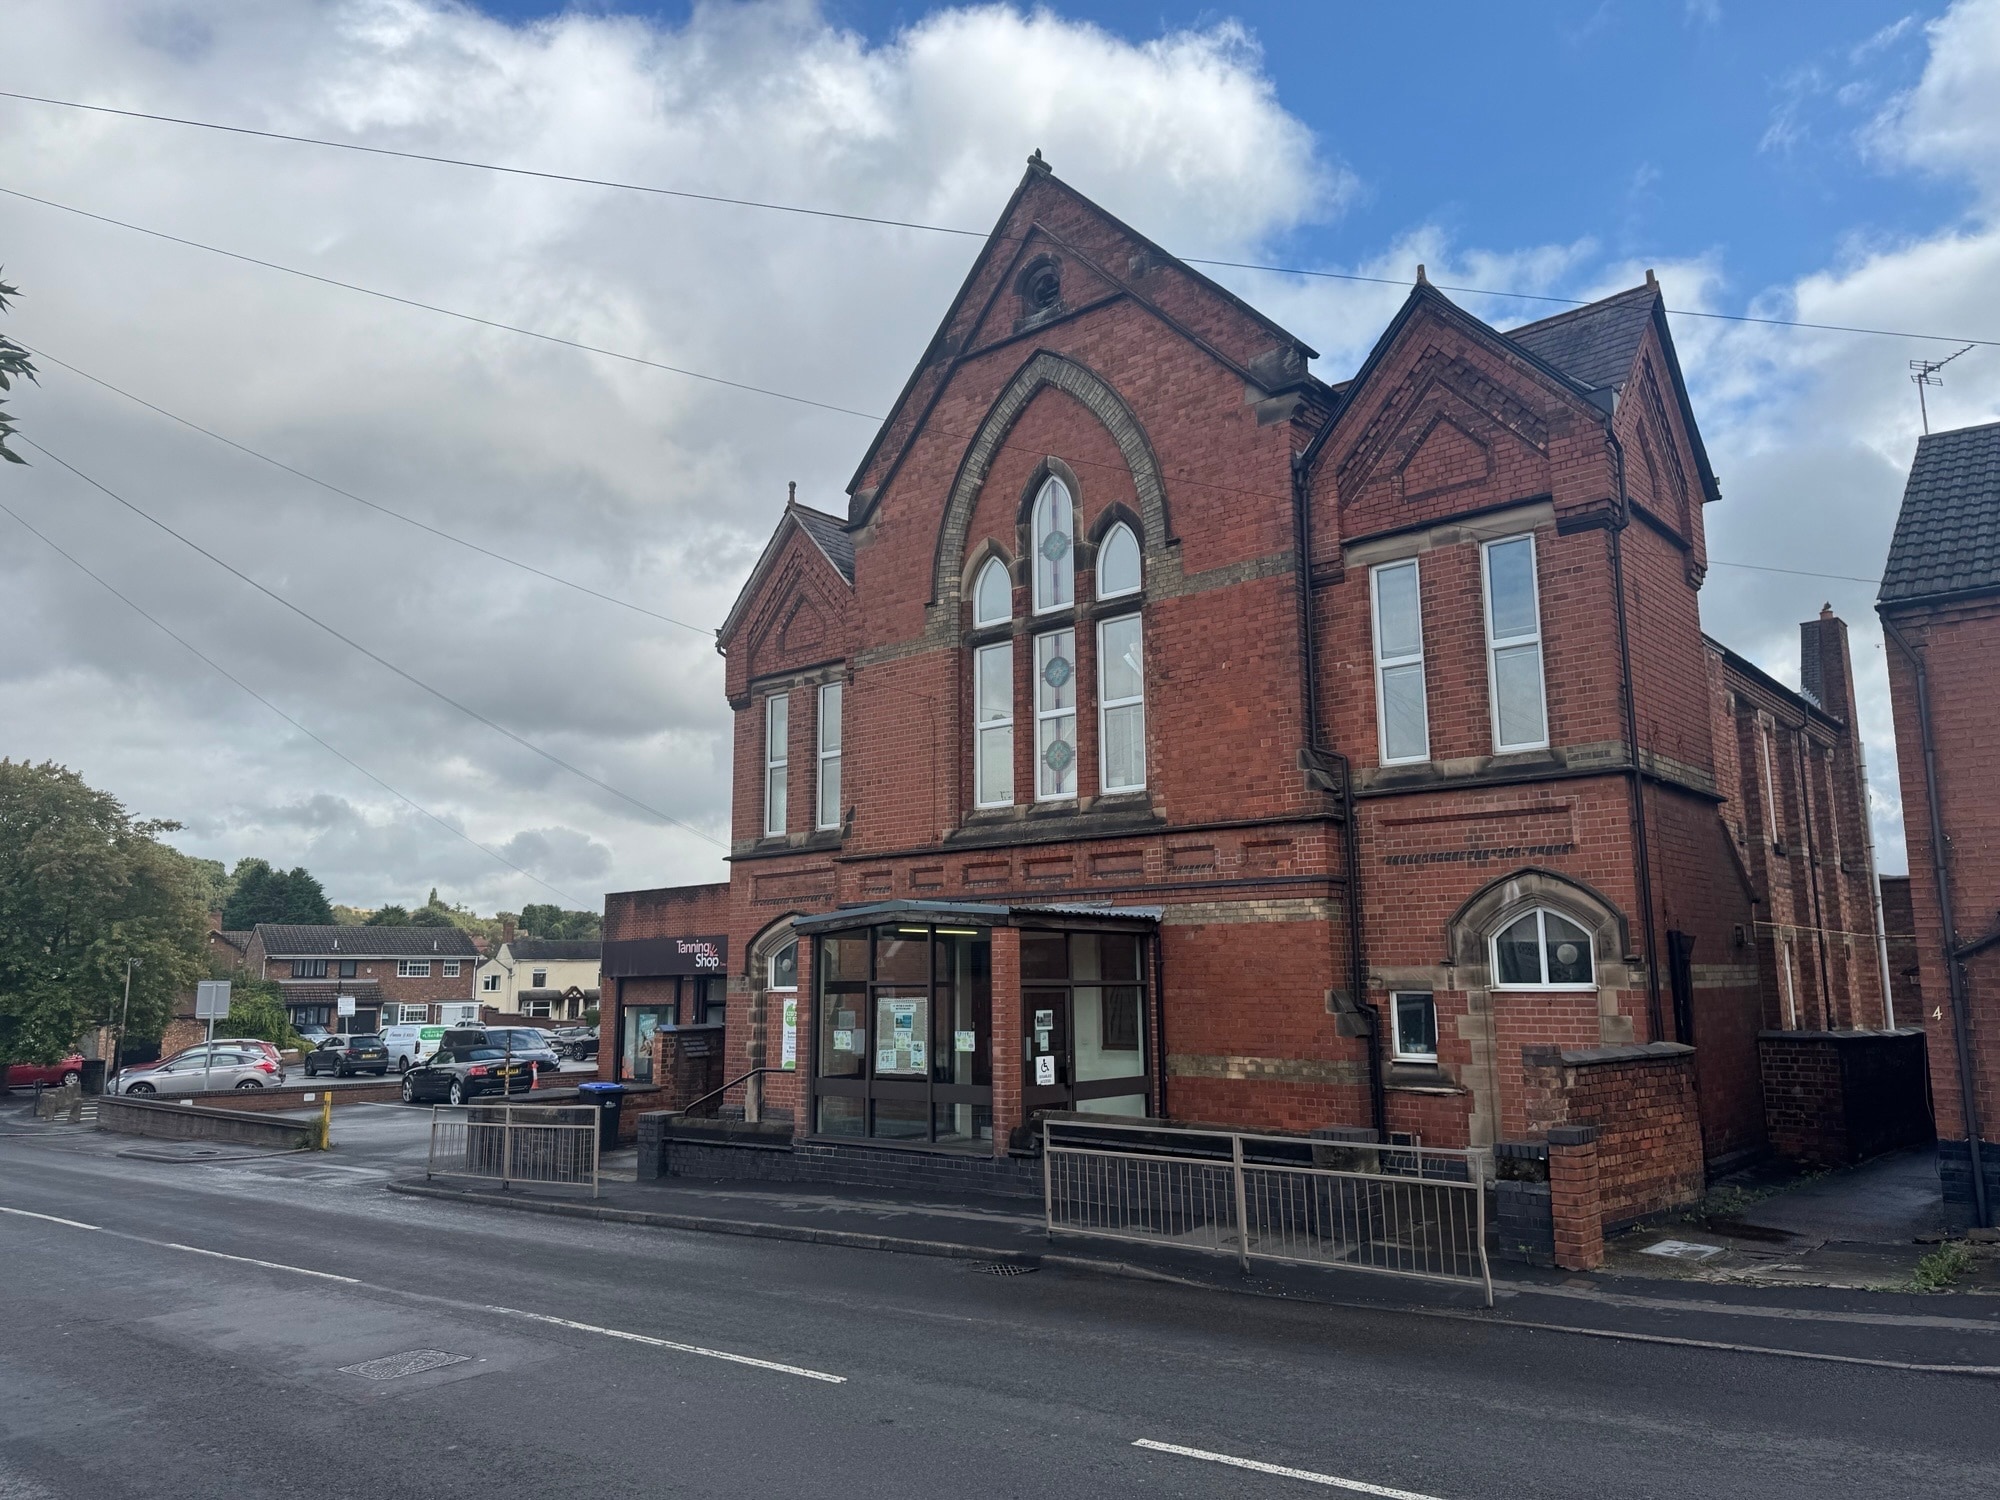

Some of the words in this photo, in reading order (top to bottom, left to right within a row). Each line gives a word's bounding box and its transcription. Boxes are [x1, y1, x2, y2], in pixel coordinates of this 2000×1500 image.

[676, 939, 711, 957] Tanning
[695, 953, 719, 971] Shop
[1932, 1005, 1943, 1021] 4
